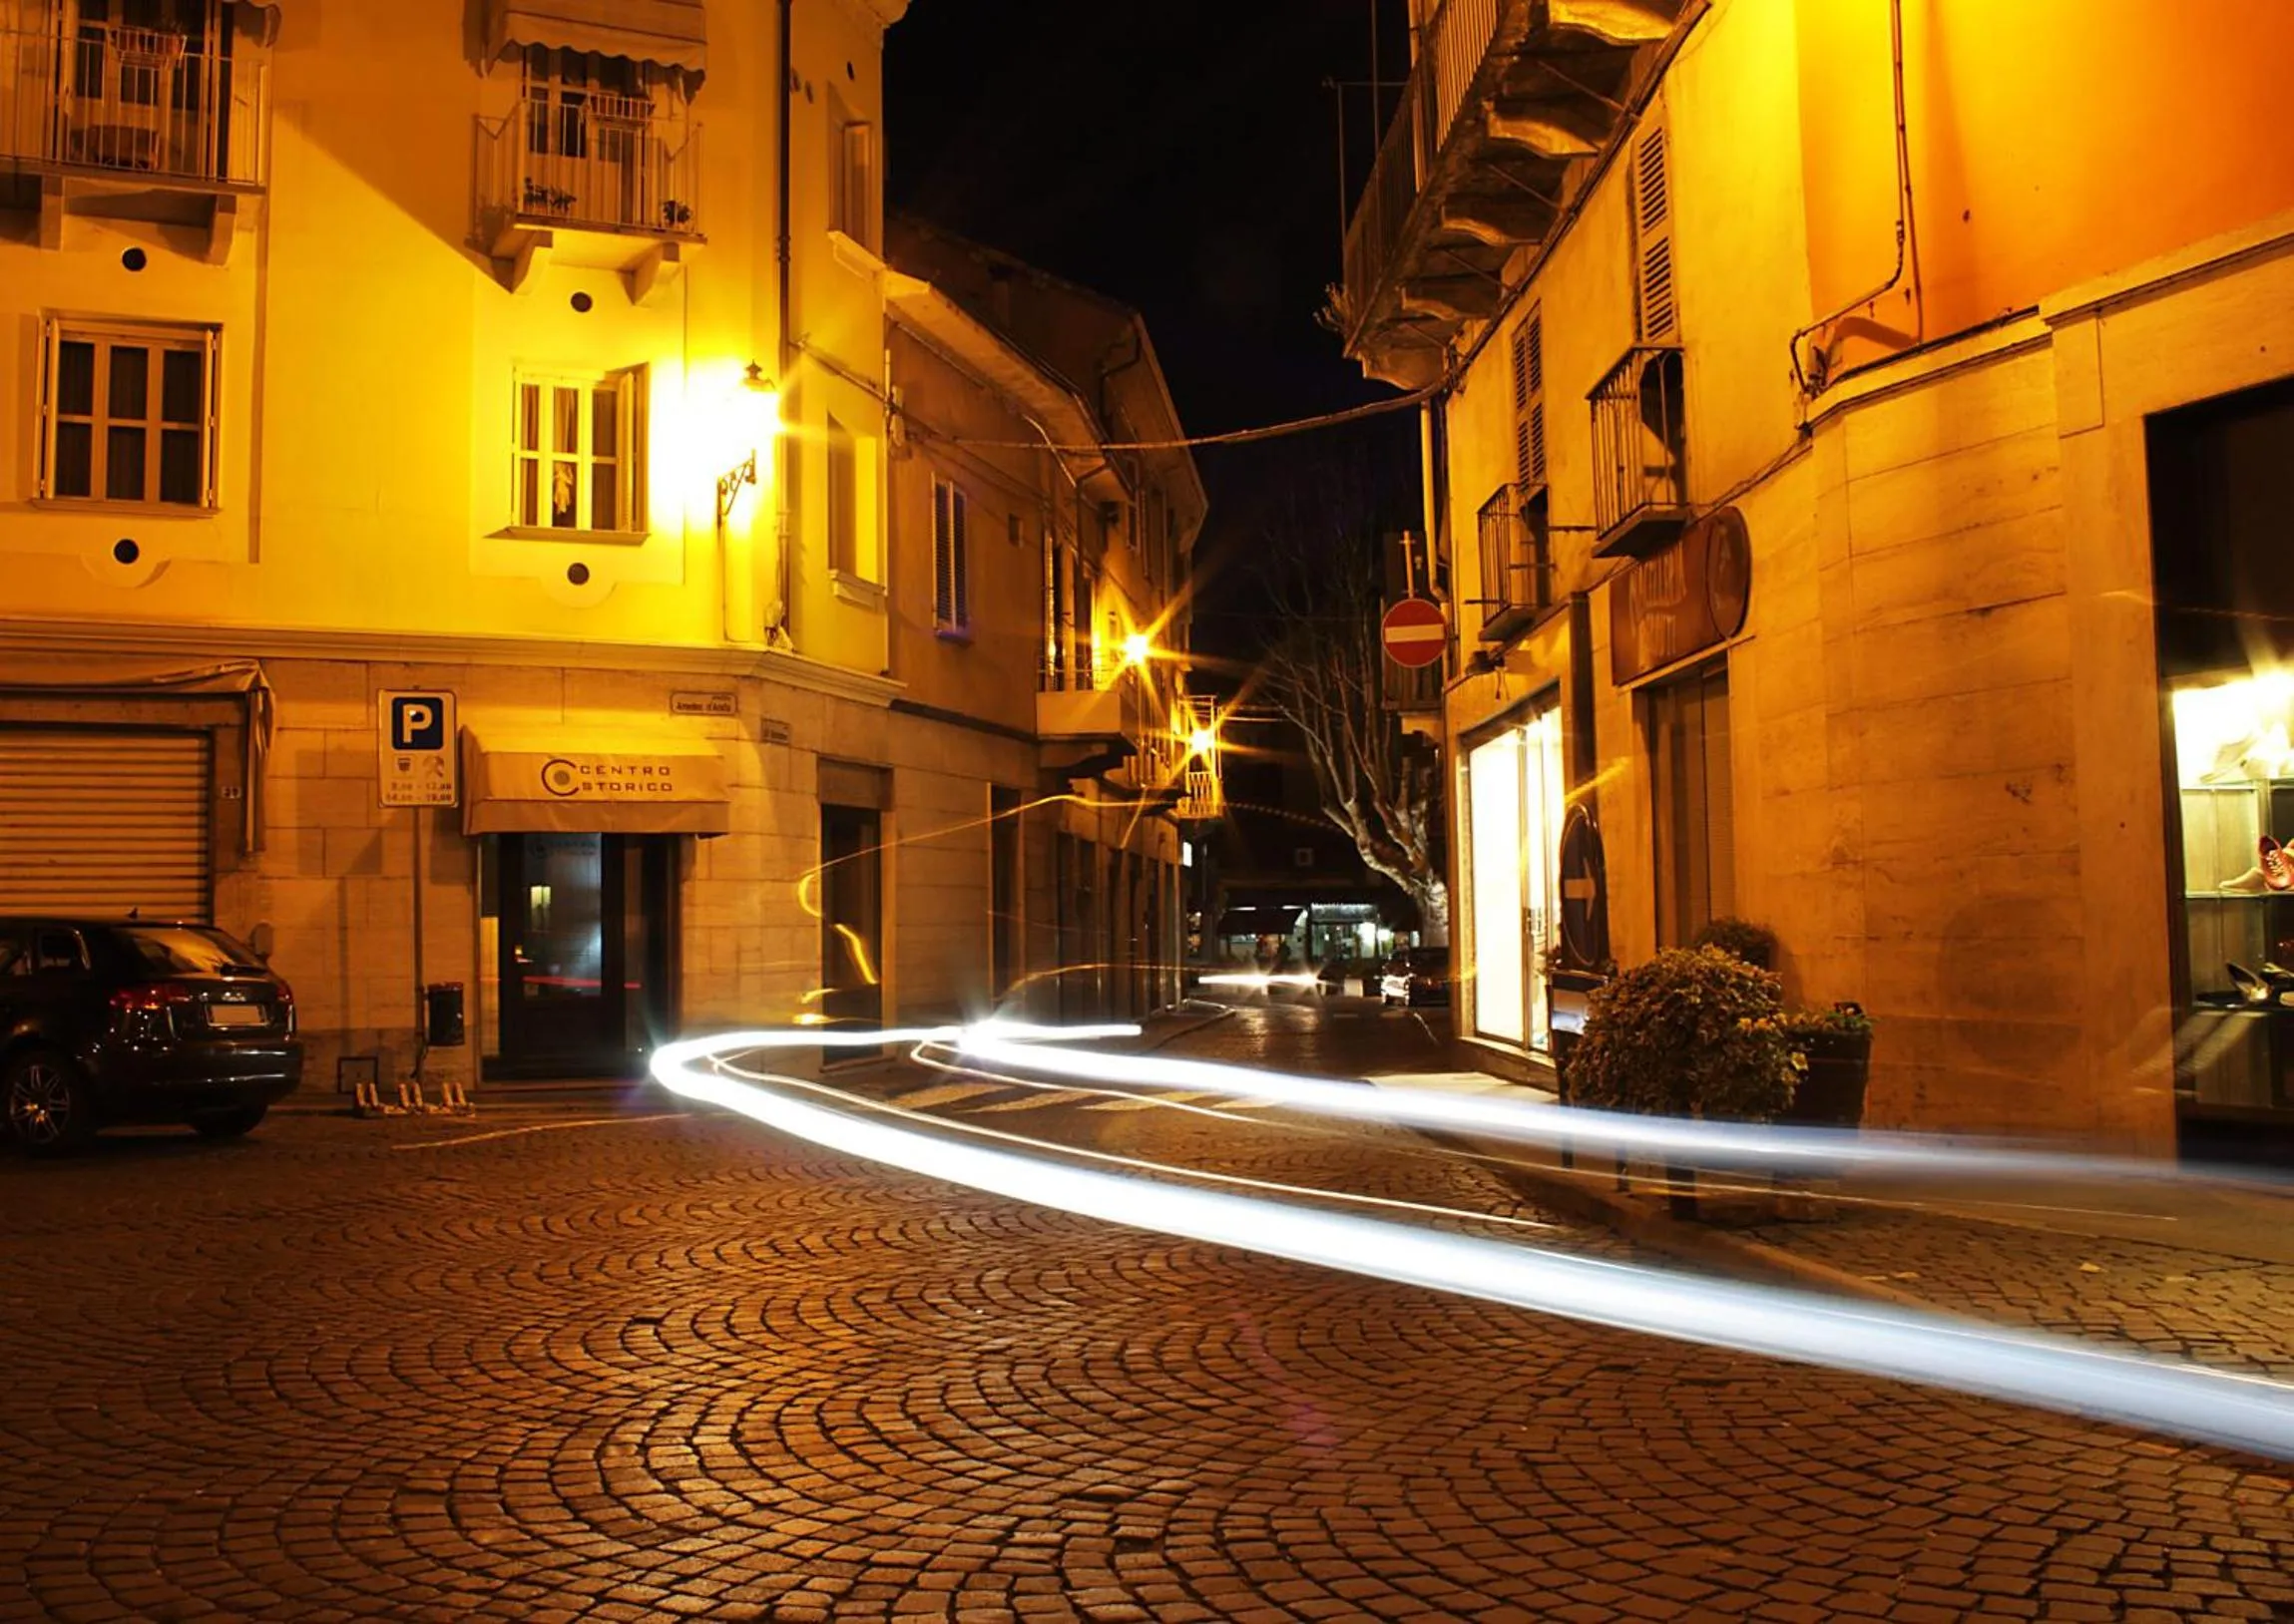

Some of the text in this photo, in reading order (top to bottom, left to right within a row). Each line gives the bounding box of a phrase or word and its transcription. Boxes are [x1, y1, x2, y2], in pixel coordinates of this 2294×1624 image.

[403, 703, 433, 743] P
[580, 765, 671, 775] CENTRO
[582, 782, 673, 791] STORICO
